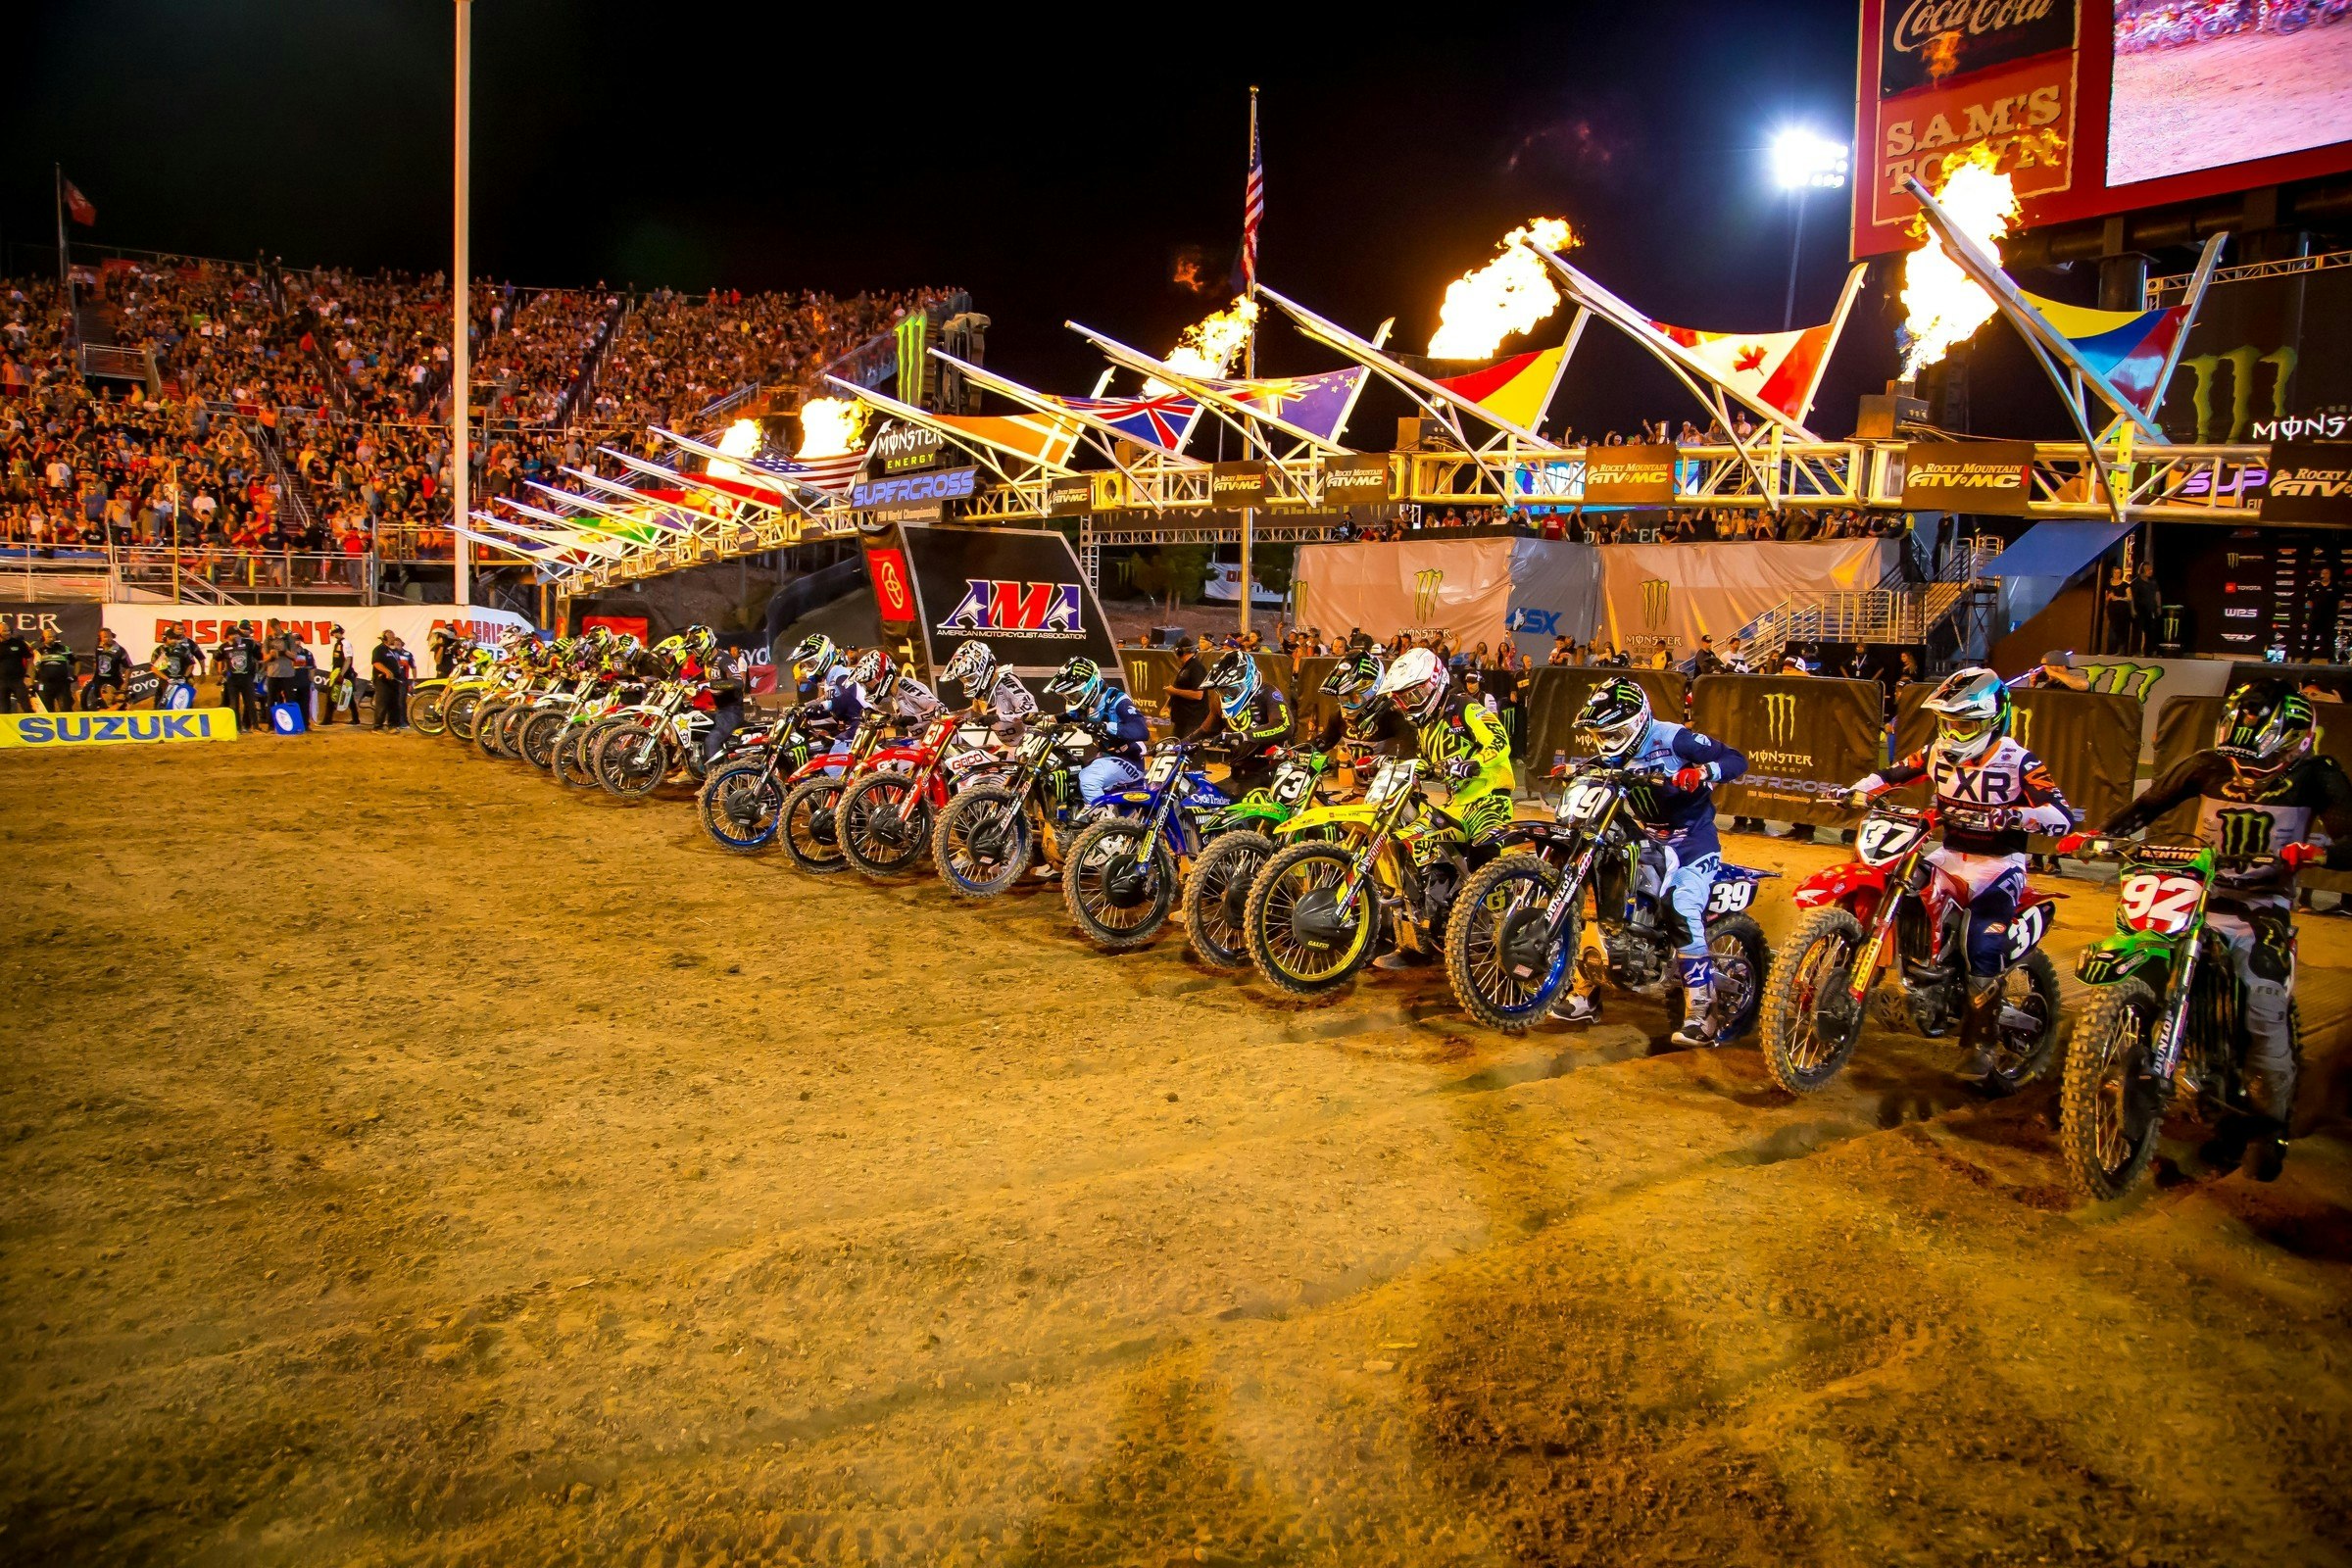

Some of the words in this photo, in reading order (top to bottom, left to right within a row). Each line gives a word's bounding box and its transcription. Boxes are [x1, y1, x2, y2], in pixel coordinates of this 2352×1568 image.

[1886, 85, 2062, 158] SAM'S
[887, 453, 934, 469] ENERGY
[1599, 464, 1625, 472] ROCKY
[1626, 463, 1668, 471] MOUNTAIN
[1925, 463, 1961, 473] ROCKY
[1961, 463, 2023, 473] MOUNTAIN
[2295, 468, 2346, 480] ROCKY
[853, 469, 977, 508] SUPERCROSS
[904, 506, 941, 519] Championship
[937, 579, 1086, 633] AMA
[2225, 609, 2258, 617] WPS
[979, 630, 1037, 639] MOTORCYCLIST
[18, 713, 211, 743] SUZUKI
[952, 754, 983, 770] GEICO
[1748, 750, 1813, 767] MONSTER
[1758, 764, 1802, 773] ENERGY
[1935, 760, 2011, 804] FXR
[1558, 784, 1612, 819] 39
[1774, 792, 1810, 804] Championship
[1864, 819, 1921, 854] 37
[2140, 849, 2201, 860] RENTHA
[1709, 881, 1751, 913] 39
[2123, 874, 2203, 934] 92
[2009, 906, 2043, 960] 37
[2154, 1009, 2173, 1076] DUNLOP
